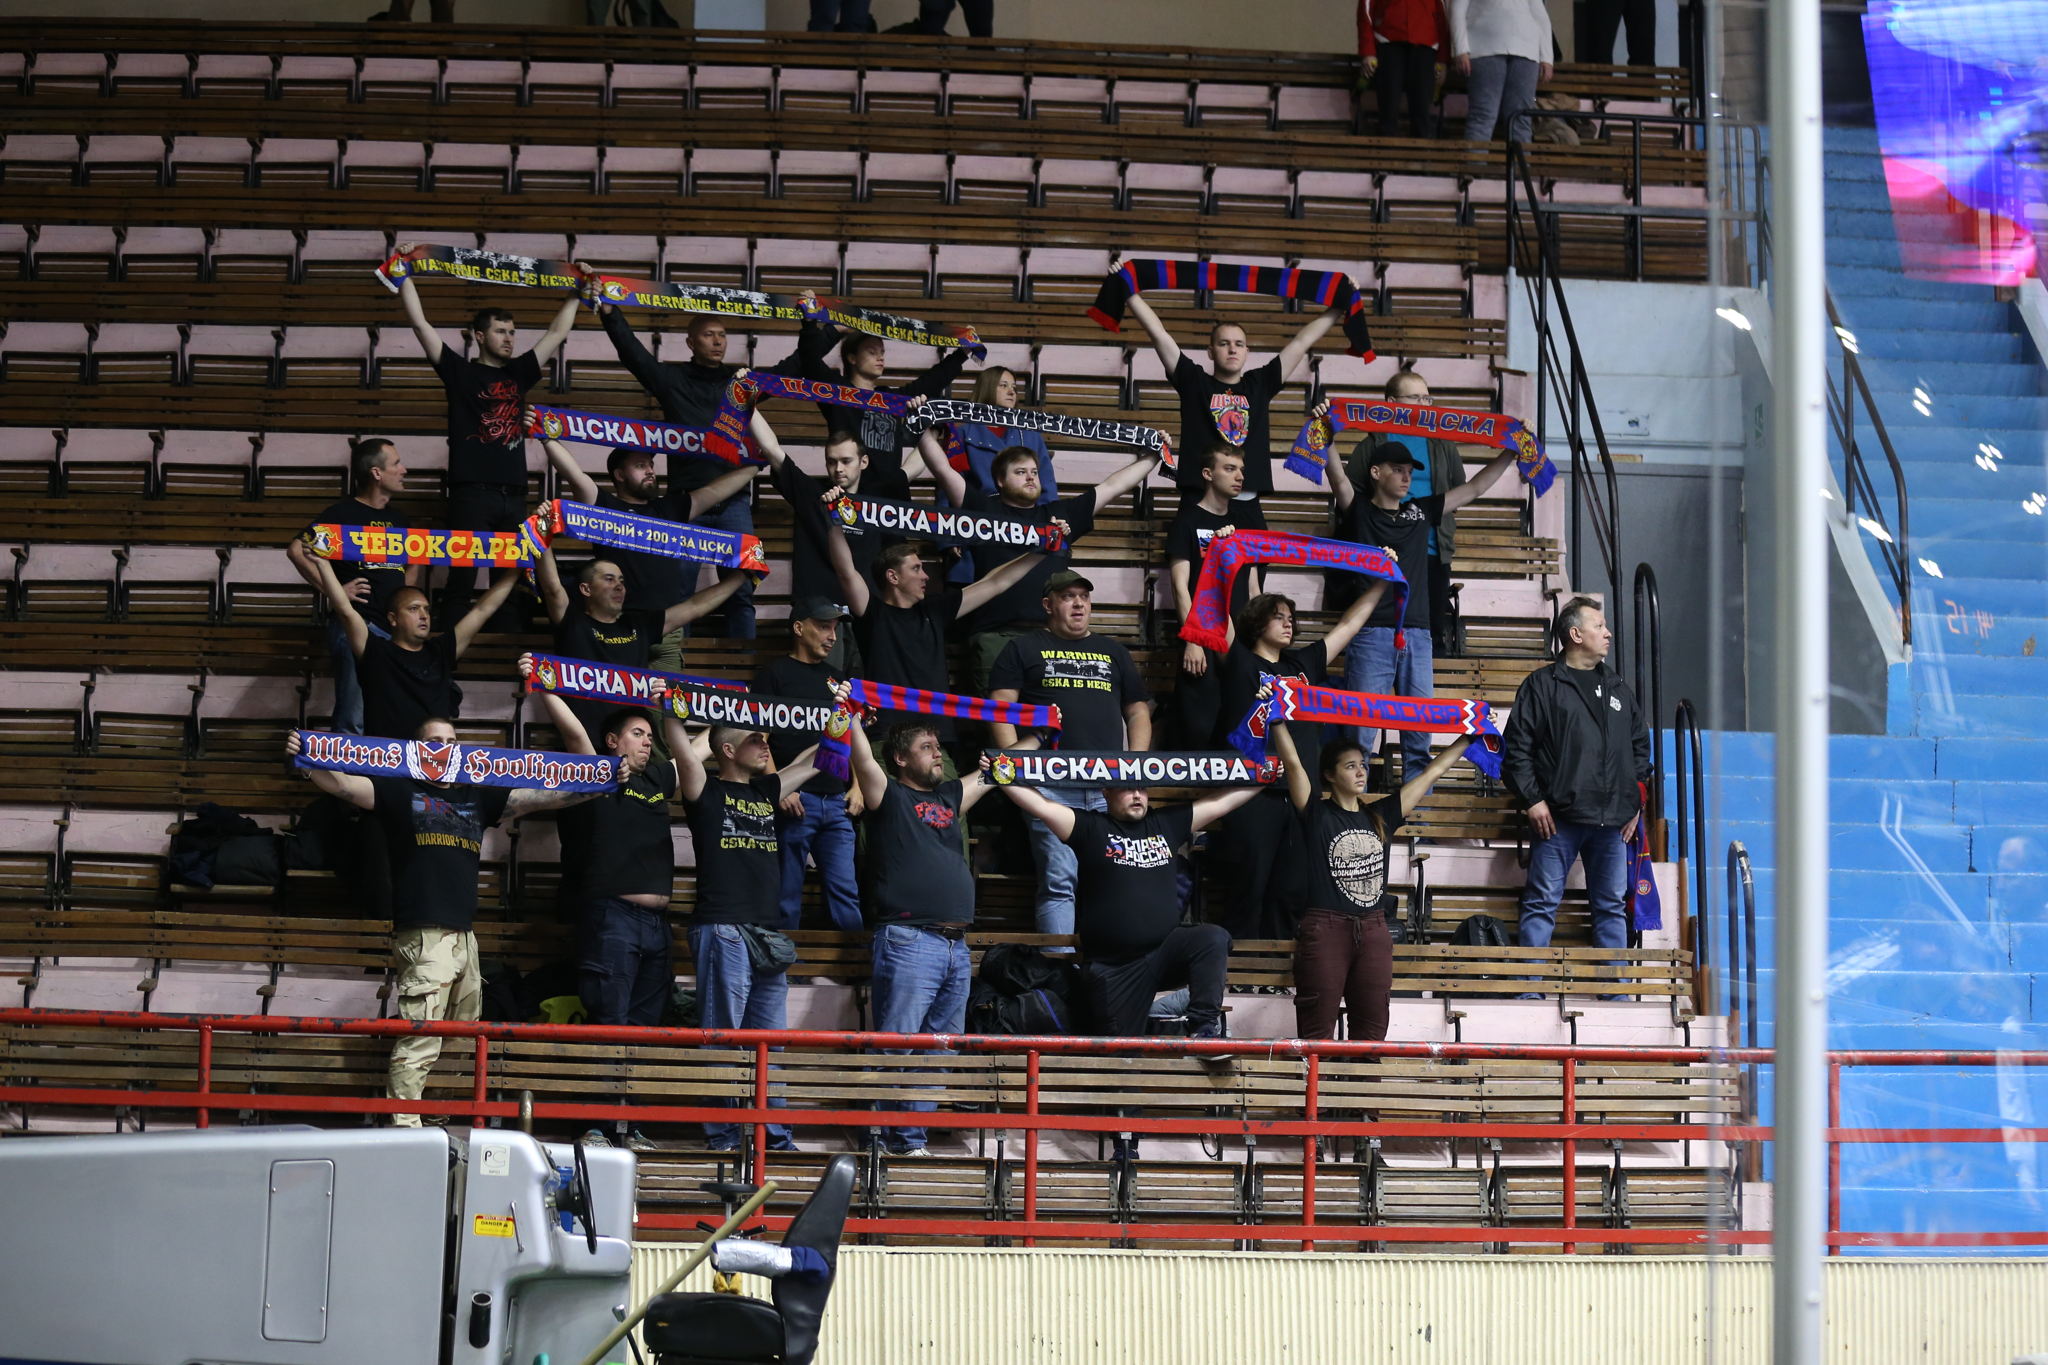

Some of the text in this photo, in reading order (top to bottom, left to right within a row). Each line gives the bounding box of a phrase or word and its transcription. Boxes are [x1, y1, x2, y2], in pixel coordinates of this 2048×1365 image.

[412, 259, 577, 288] WARNING CSKA IS HERE
[635, 293, 711, 311] WARNING
[716, 301, 754, 316] CSKA
[758, 305, 773, 318] IS
[828, 308, 882, 335] WARNING
[886, 326, 914, 343] CSKA
[917, 332, 928, 345] IS
[780, 377, 889, 410] ЦСКА
[566, 415, 641, 446] ЦСКА
[1346, 403, 1496, 438] ПФК ЦСКА
[567, 512, 635, 538] ШУСТРЫЙ
[646, 529, 669, 544] 200
[680, 535, 696, 549] ЗА
[699, 538, 734, 556] ЦСКА
[861, 501, 1040, 546] ЦСКА МОСКВА
[350, 531, 531, 561] ЧЕБОКСАРЫ
[1241, 540, 1300, 562] ЦСКА
[1310, 546, 1394, 577] МОСКВА
[1041, 650, 1112, 663] WARNING
[561, 663, 627, 696] ЦСКА
[1042, 678, 1112, 692] CSKA IS HERE
[691, 691, 831, 731] ЦСКА МОСКВ
[1297, 687, 1462, 725] ЦСКА МОСКВА
[306, 734, 402, 769] Ultras
[423, 750, 443, 773] ЦСКА
[464, 750, 613, 788] Hooligans
[1023, 756, 1250, 782] ЦСКА МОСКВА
[1138, 859, 1170, 868] МОСКВА
[1334, 857, 1346, 868] На
